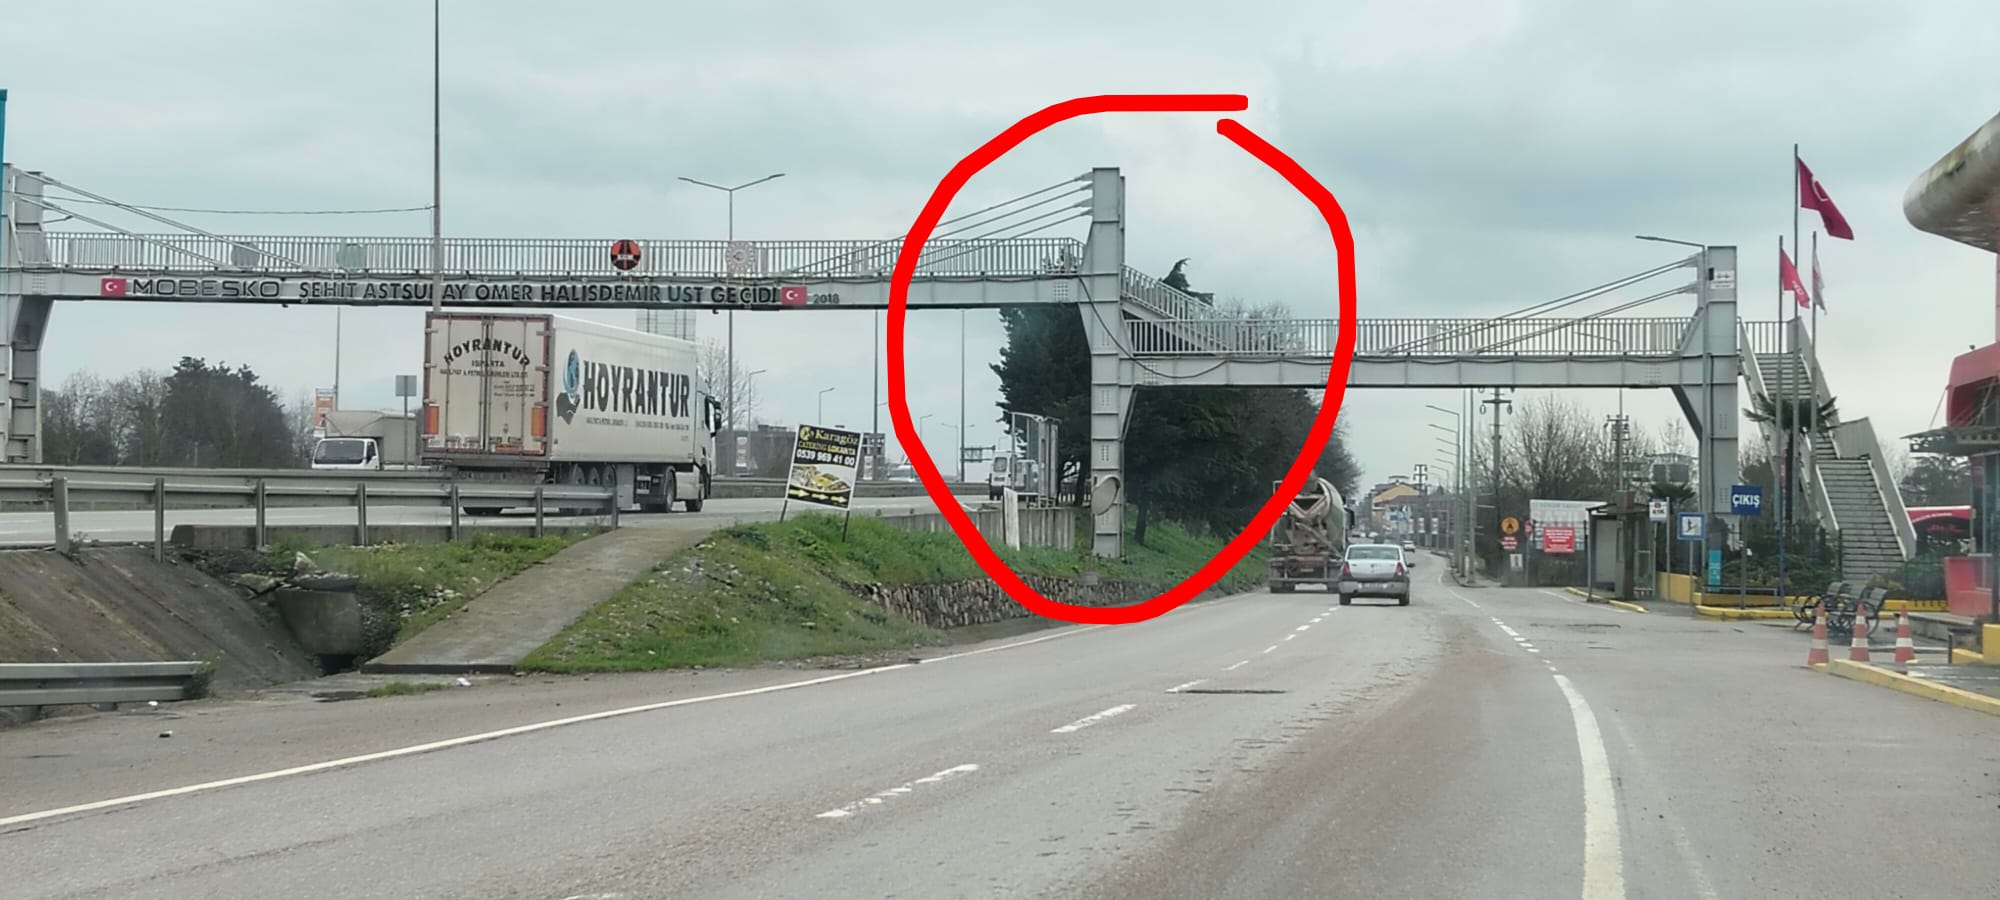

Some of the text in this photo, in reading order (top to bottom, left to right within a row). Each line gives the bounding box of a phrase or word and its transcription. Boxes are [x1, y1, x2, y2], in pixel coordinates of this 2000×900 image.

[132, 279, 280, 297] MOBESKO
[363, 282, 466, 300] ASTSUAY
[812, 294, 841, 304] 2018
[443, 338, 530, 366] HOYRANTUR
[583, 360, 690, 418] HOYRANTUR
[815, 429, 859, 446] Karagöz
[796, 448, 816, 460] 0539
[833, 455, 844, 464] 41
[844, 456, 855, 466] 00
[1732, 495, 1760, 508] ÇIKIŞ
